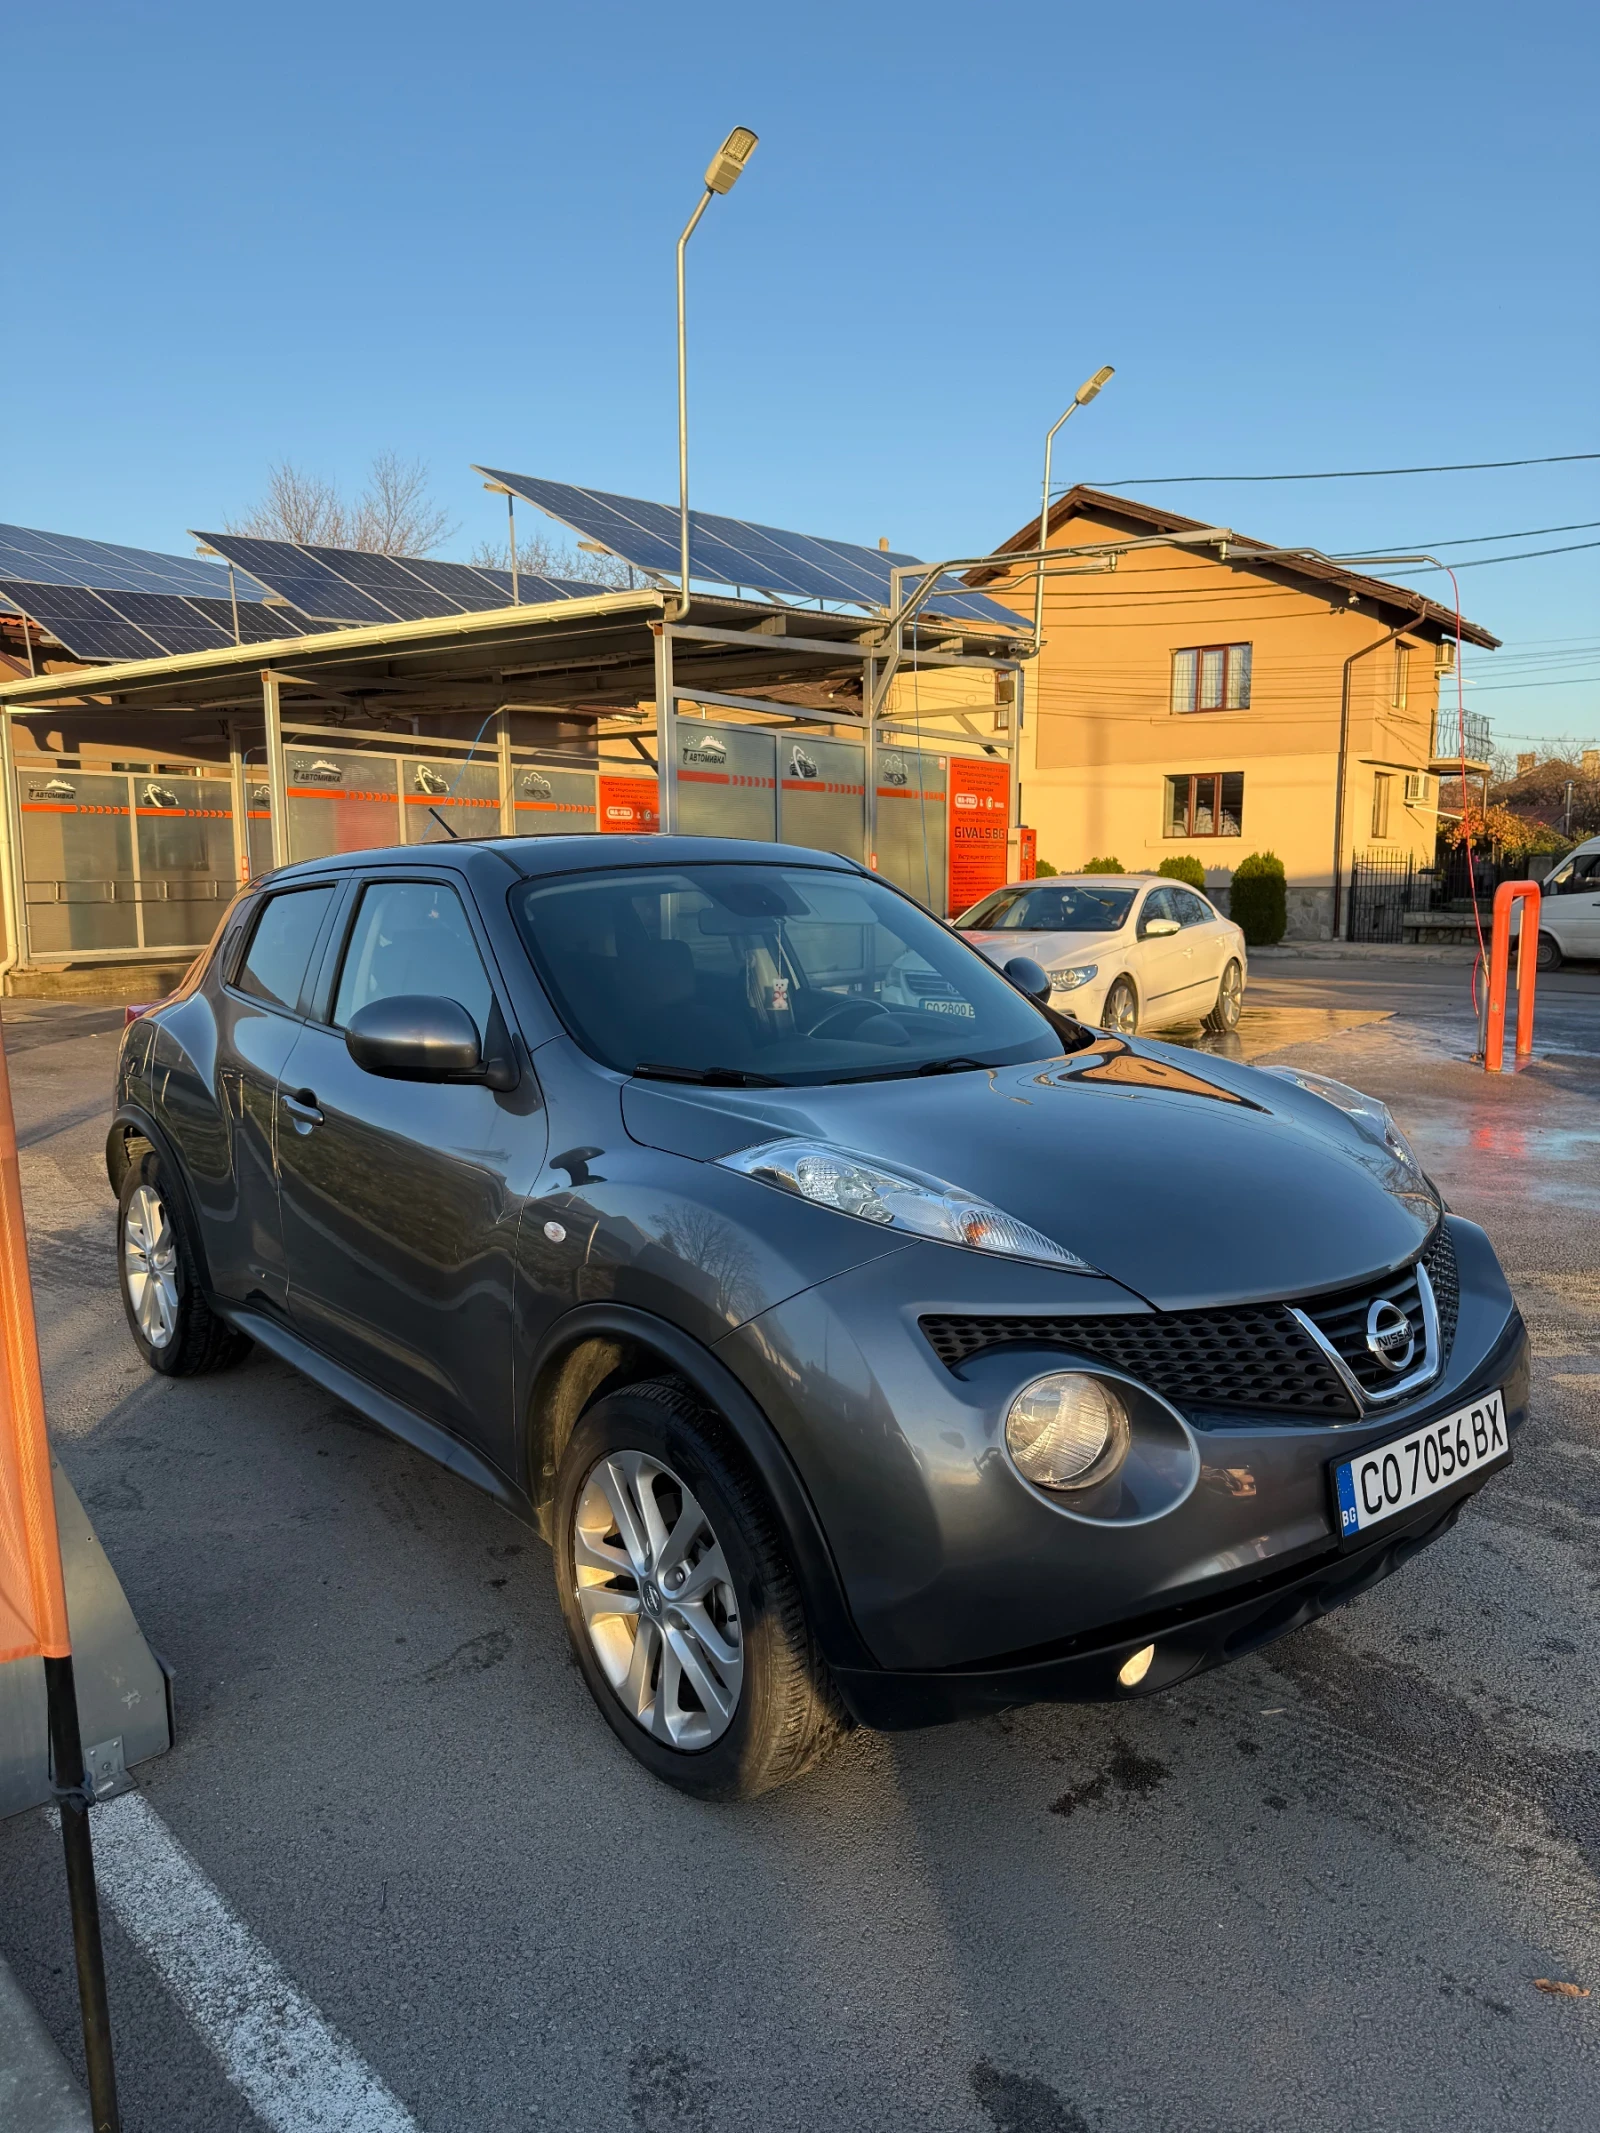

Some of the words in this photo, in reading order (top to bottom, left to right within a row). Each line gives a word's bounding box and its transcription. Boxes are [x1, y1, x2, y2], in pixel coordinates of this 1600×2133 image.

[689, 753, 725, 764] АВТОМИВКА
[300, 773, 341, 783] АВТОМИВКА
[35, 791, 74, 800] АВТОМИВКА
[954, 826, 1005, 839] GIVALS.BG
[1361, 1453, 1402, 1515] CO
[1404, 1418, 1470, 1496] 7056
[1471, 1399, 1503, 1459] BX
[1341, 1507, 1357, 1527] BG
